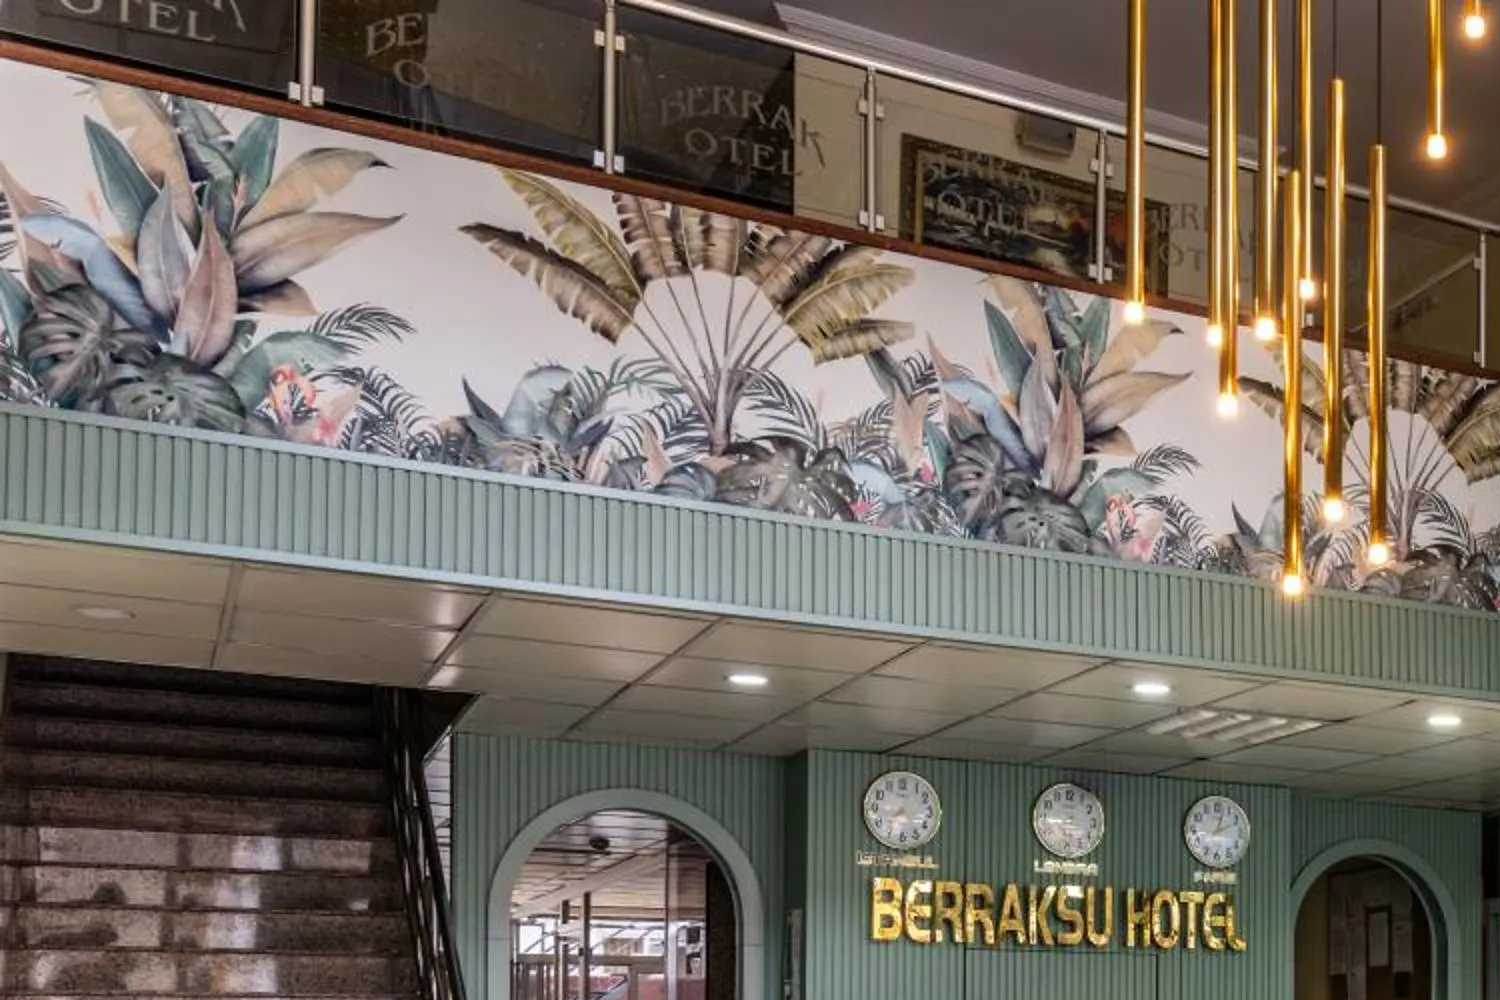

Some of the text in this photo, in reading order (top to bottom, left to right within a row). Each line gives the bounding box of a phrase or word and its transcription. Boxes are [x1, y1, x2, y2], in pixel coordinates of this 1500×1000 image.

[661, 84, 826, 170] BERRAK
[684, 127, 803, 177] OTEL
[872, 876, 1247, 952] BERRAKSU HOTEL
